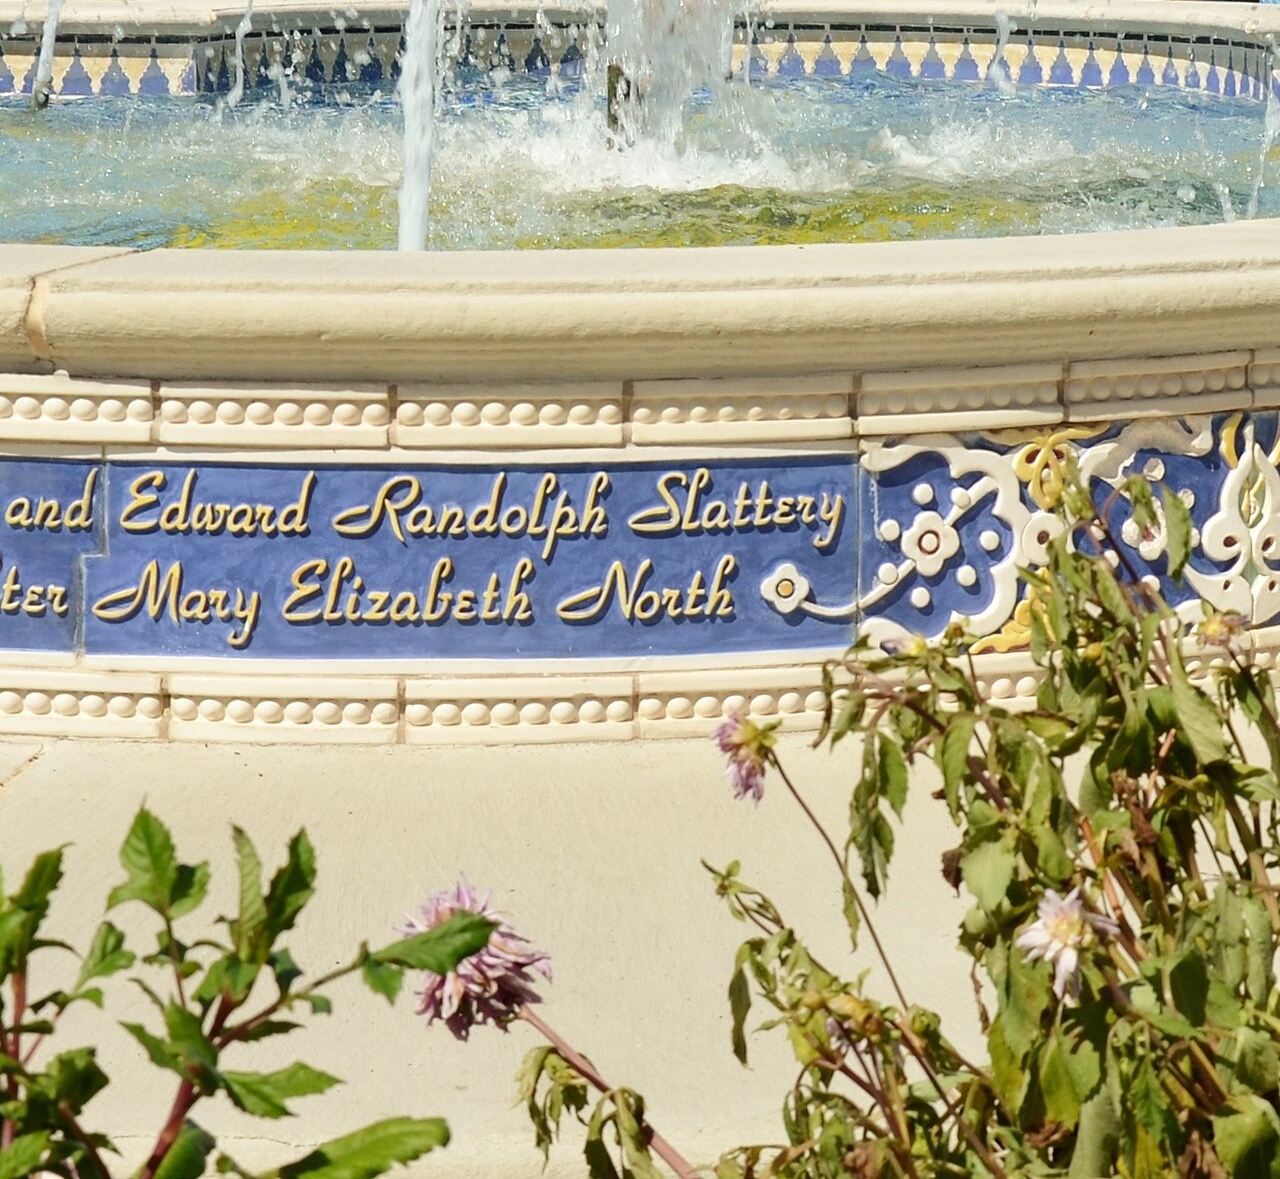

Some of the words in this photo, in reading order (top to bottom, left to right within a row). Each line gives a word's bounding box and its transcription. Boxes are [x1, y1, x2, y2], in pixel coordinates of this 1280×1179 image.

[5, 467, 99, 528] and
[120, 469, 317, 534] Edward
[332, 472, 611, 560] Randolph
[628, 469, 842, 548] Slattery
[91, 559, 261, 646] Mary
[281, 557, 535, 622] Elizabeth
[556, 554, 735, 621] North
